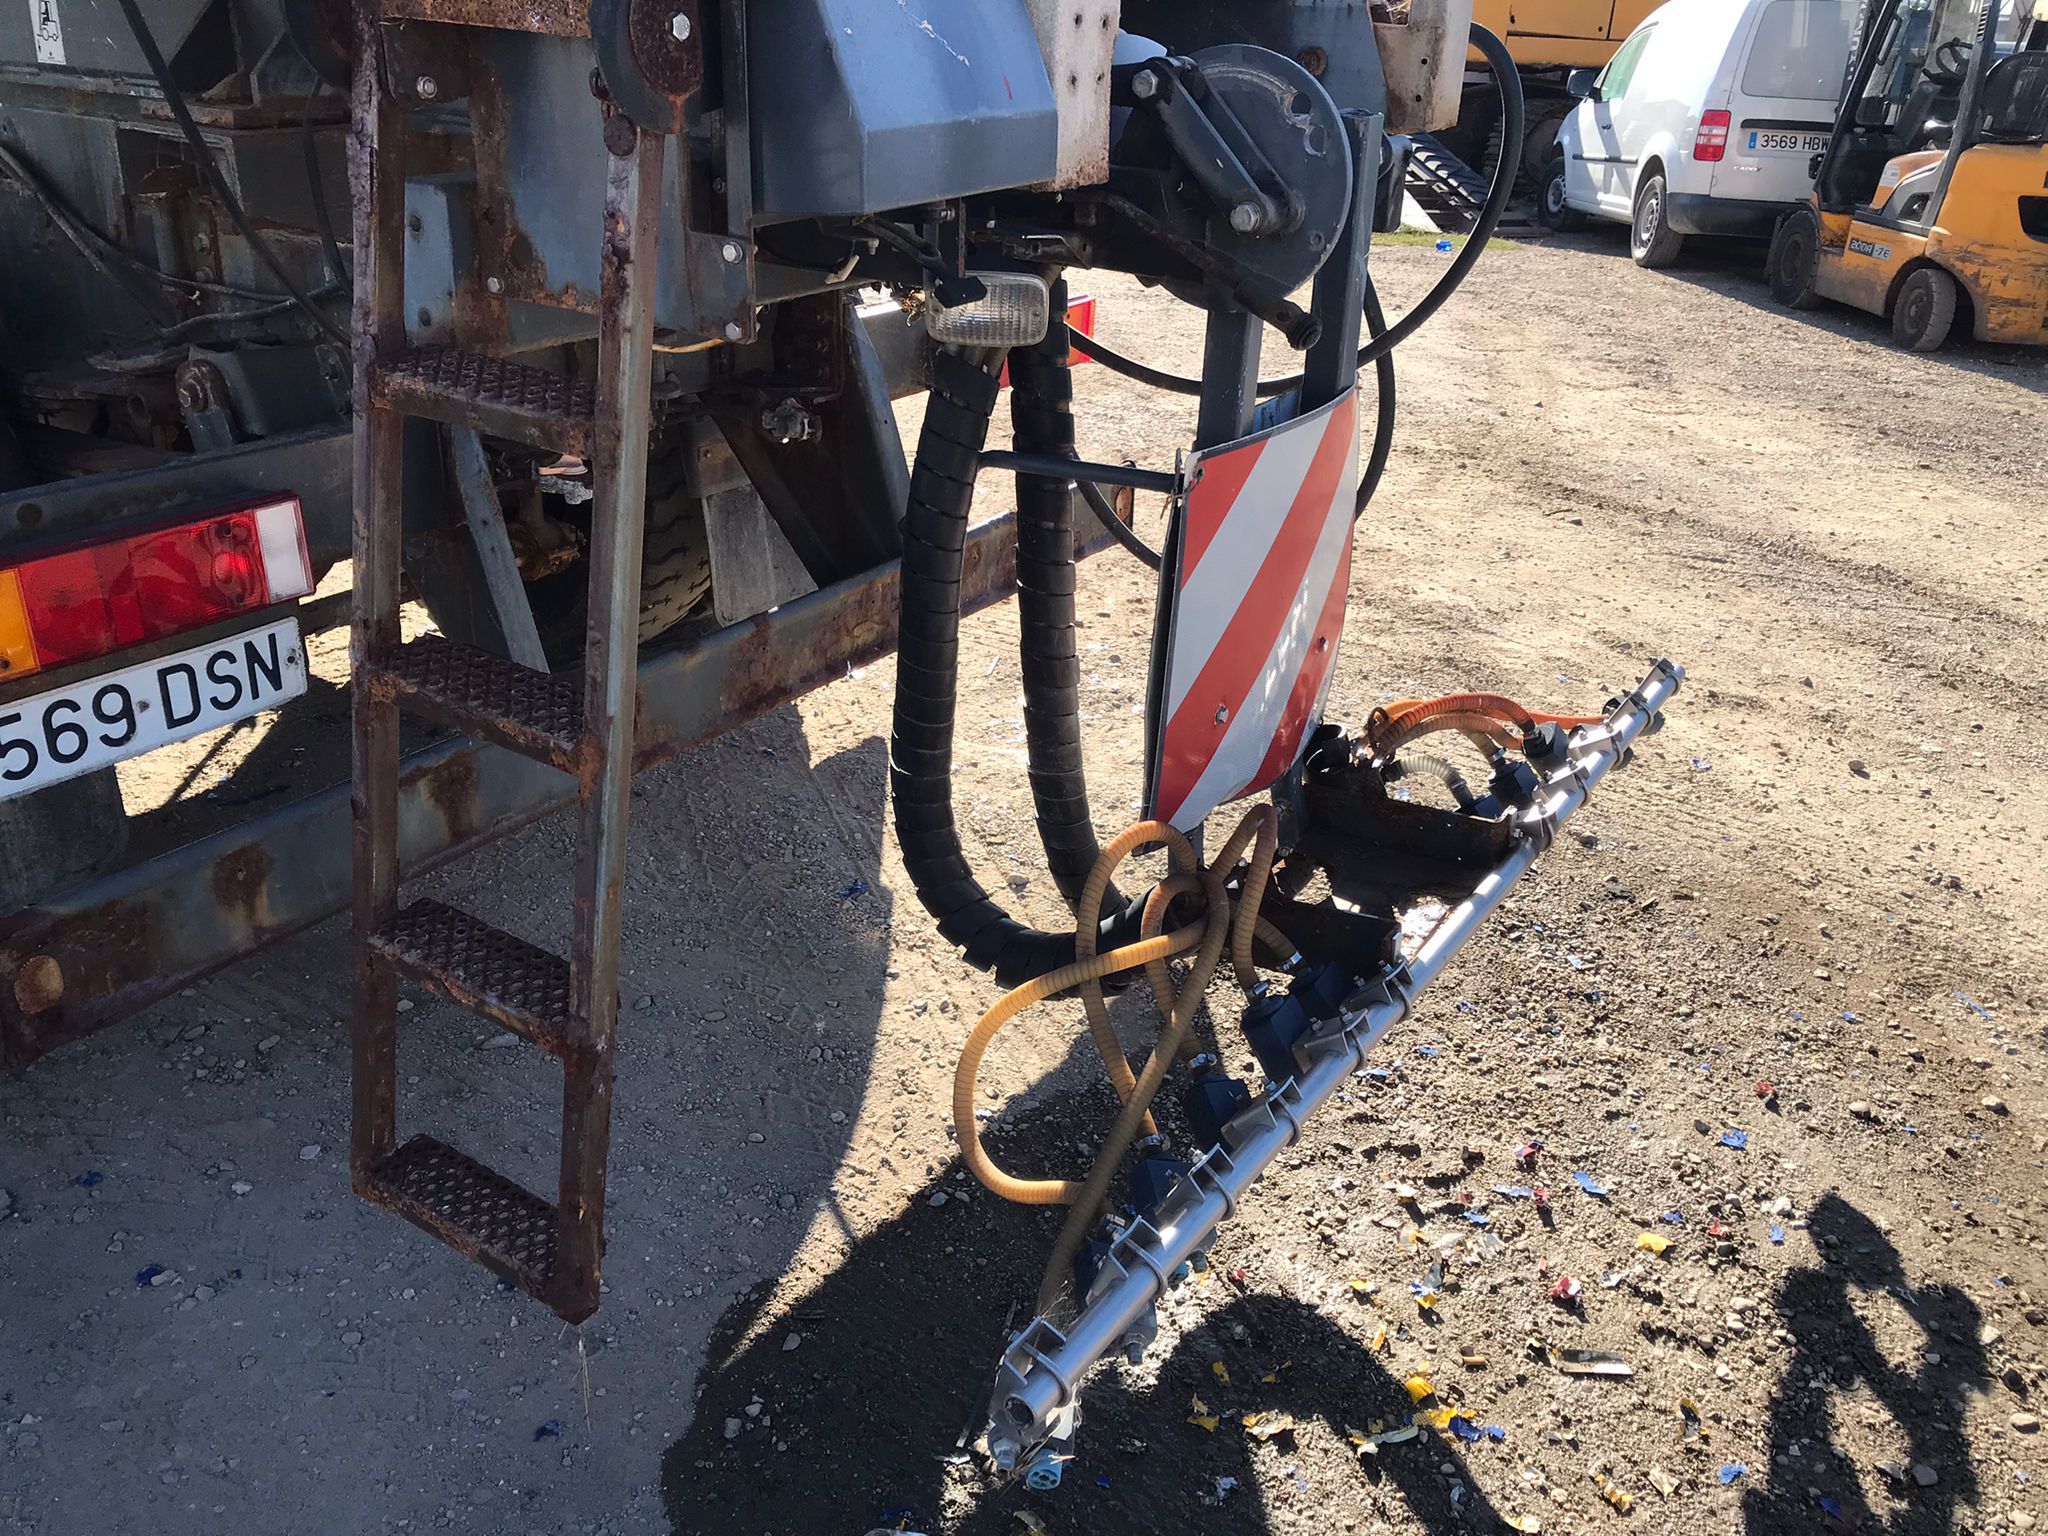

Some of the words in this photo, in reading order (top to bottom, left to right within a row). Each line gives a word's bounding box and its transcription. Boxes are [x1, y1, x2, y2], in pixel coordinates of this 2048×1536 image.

[1760, 134, 1798, 150] 3569
[0, 683, 137, 781] 569
[157, 632, 283, 730] DSN
